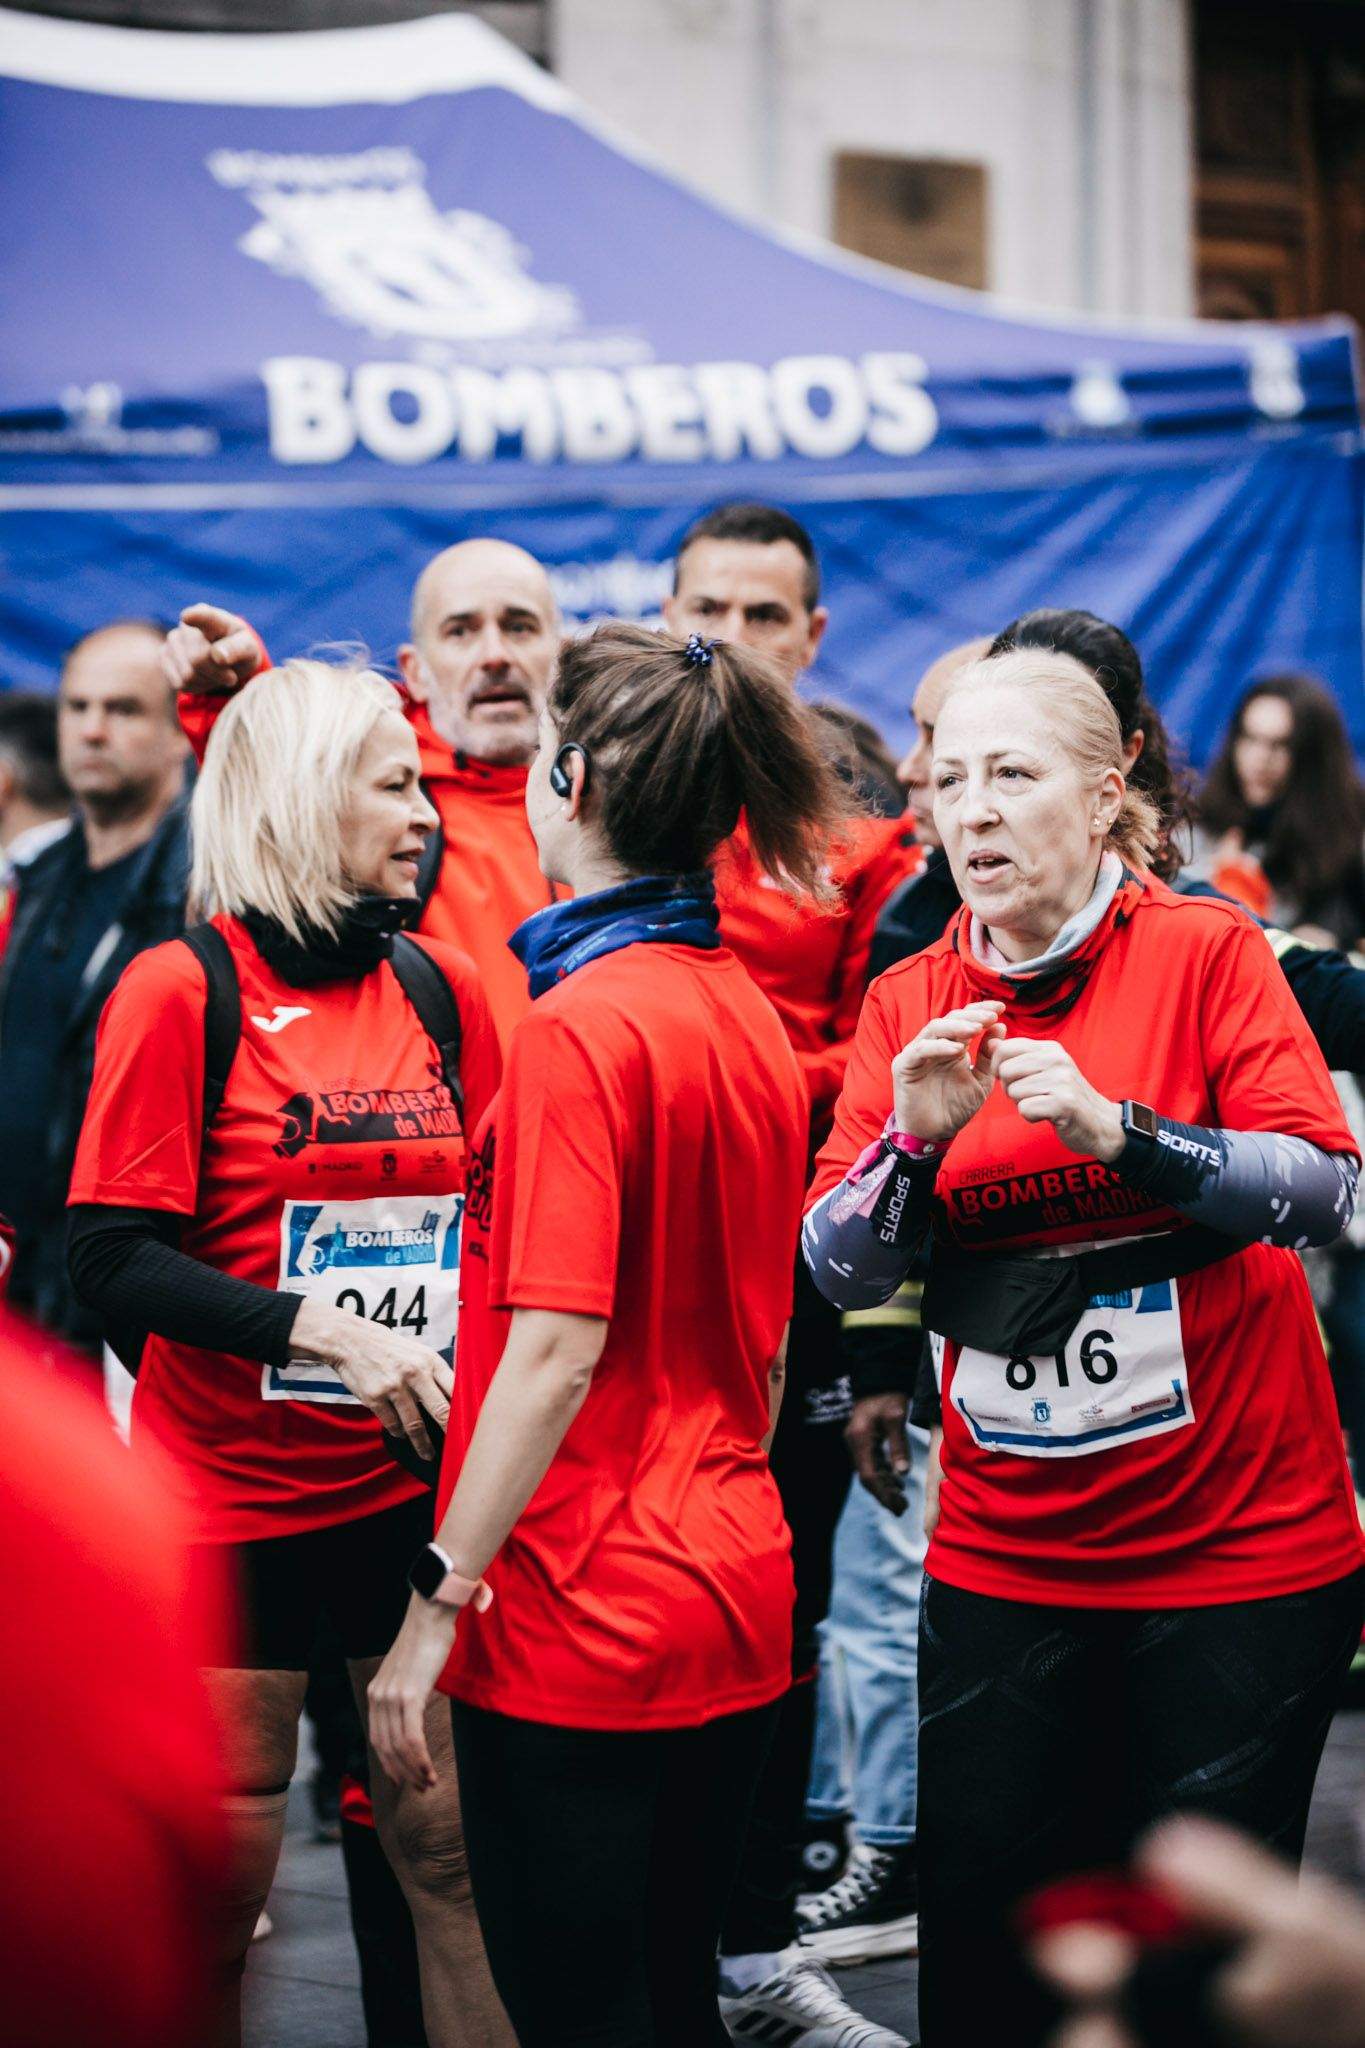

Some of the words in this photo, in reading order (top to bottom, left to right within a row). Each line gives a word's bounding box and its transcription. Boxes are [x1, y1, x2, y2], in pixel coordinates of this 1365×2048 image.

[262, 353, 939, 465] BOMBEROS
[328, 1086, 451, 1114] BOMBERO
[394, 1114, 419, 1138] de
[959, 1162, 1016, 1185] CARRERA
[960, 1163, 1122, 1215] BOMBER
[879, 1174, 911, 1243] SPORTS
[1042, 1200, 1071, 1225] de
[345, 1228, 434, 1248] BOMBEROS
